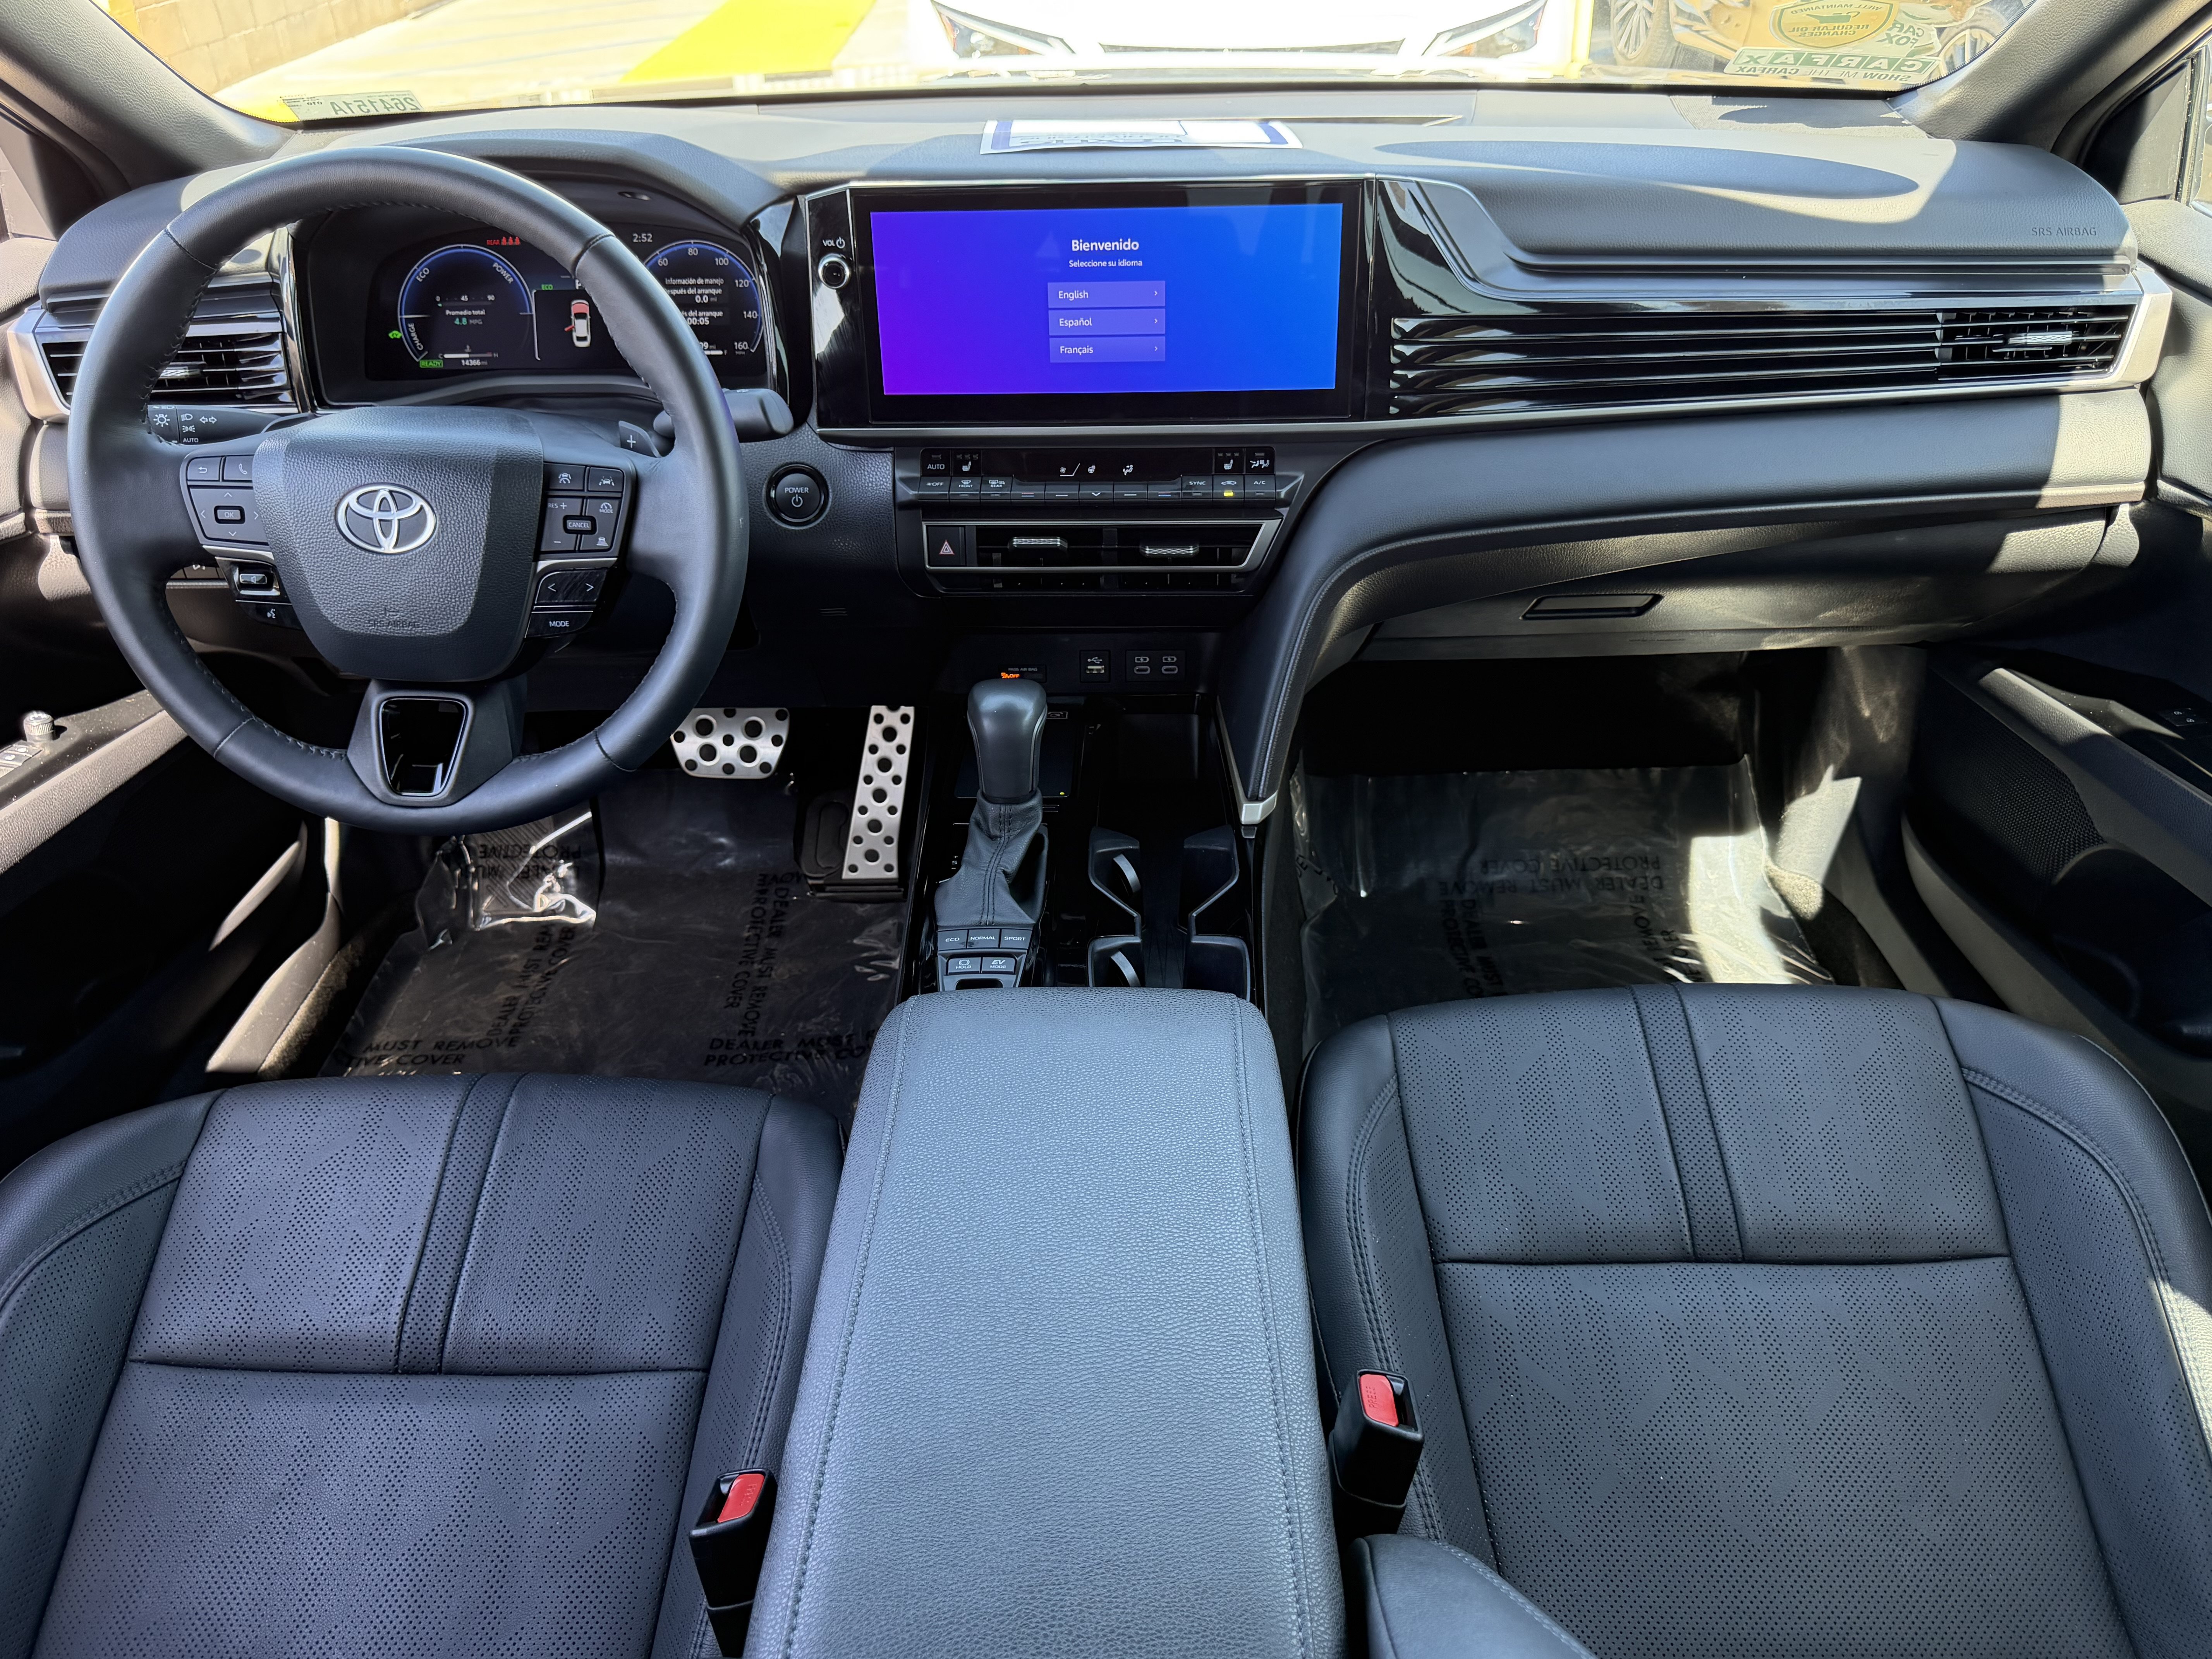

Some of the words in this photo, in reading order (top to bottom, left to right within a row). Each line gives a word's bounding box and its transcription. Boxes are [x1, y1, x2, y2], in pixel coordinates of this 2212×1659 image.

[2032, 227, 2052, 236] SRS
[2056, 227, 2097, 236] AIRBAG
[632, 233, 653, 242] 2:52
[1072, 238, 1139, 251] Bienvenido
[688, 248, 698, 256] 80
[658, 258, 668, 266] 60
[715, 258, 729, 266] 100
[416, 268, 430, 282] ECO
[492, 262, 514, 284] POWER
[705, 278, 724, 287] manejo
[735, 279, 749, 287] 120
[666, 288, 687, 296] espués
[1058, 290, 1089, 301] English
[695, 295, 708, 304] 0.0
[1059, 318, 1092, 328] Español
[408, 323, 423, 350] CHARGE
[734, 342, 748, 350] 160
[1060, 345, 1093, 356] Français
[1551, 855, 1662, 871] PROTECTIVE
[1595, 876, 1664, 890] DEALER
[363, 1039, 423, 1053] MUST
[433, 1036, 521, 1051] REMOVE
[709, 1038, 784, 1050] DEALER
[396, 1053, 464, 1065] COVER
